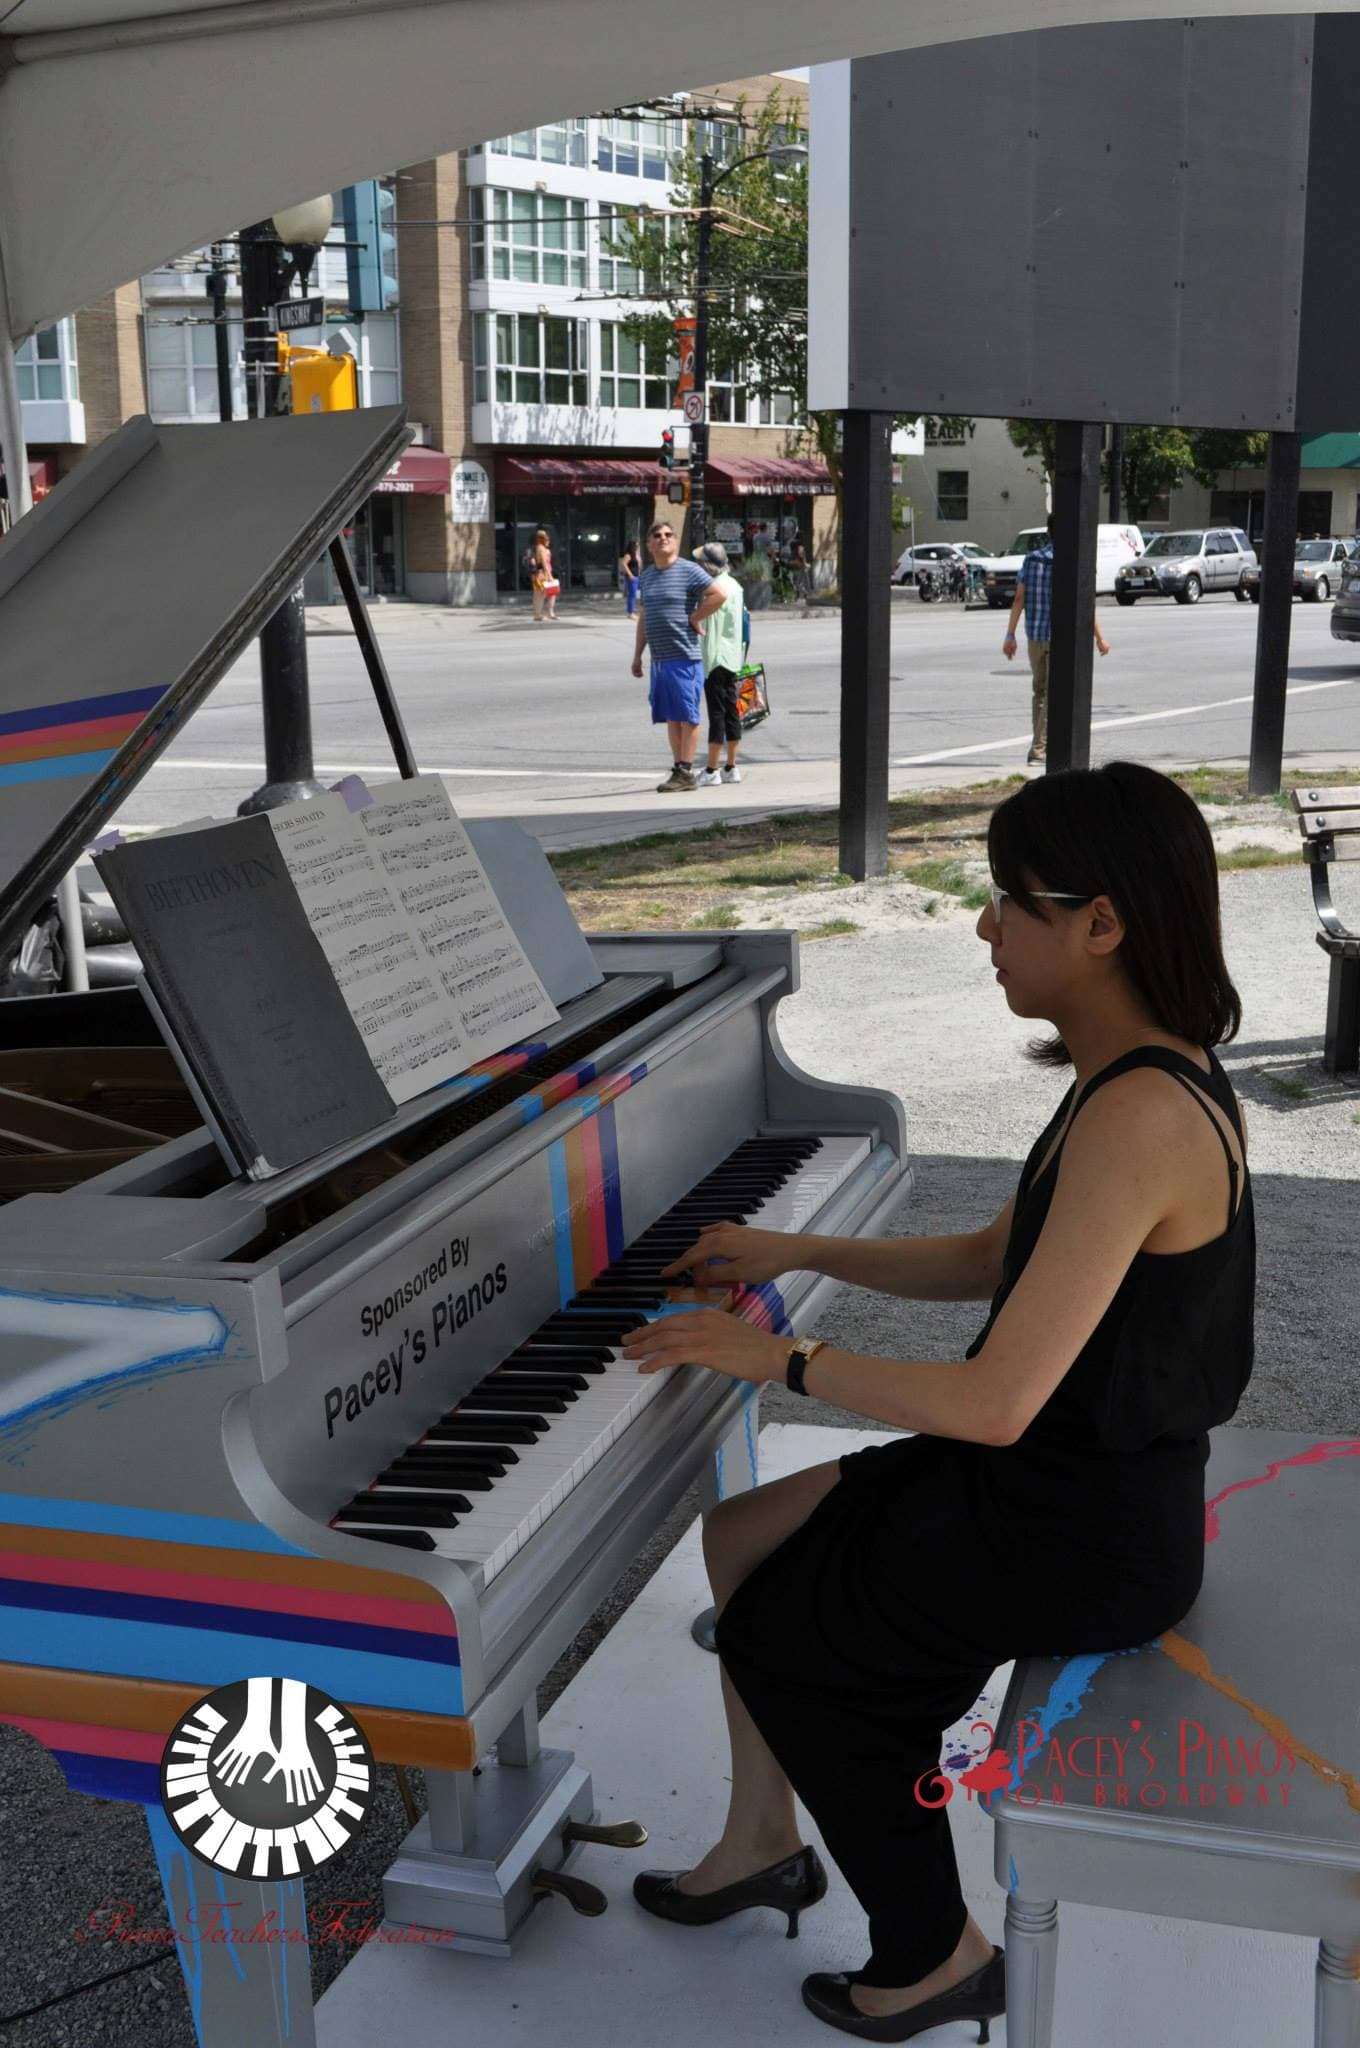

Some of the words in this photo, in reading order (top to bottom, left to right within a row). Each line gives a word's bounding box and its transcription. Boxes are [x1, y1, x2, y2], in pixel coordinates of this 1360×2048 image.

[280, 303, 312, 327] KINGSWAY
[144, 857, 281, 912] BEETHOVEN
[360, 1248, 448, 1337] Sponsored
[450, 1236, 470, 1267] By
[324, 1328, 427, 1440] Pacey's
[431, 1262, 508, 1348] Pianos
